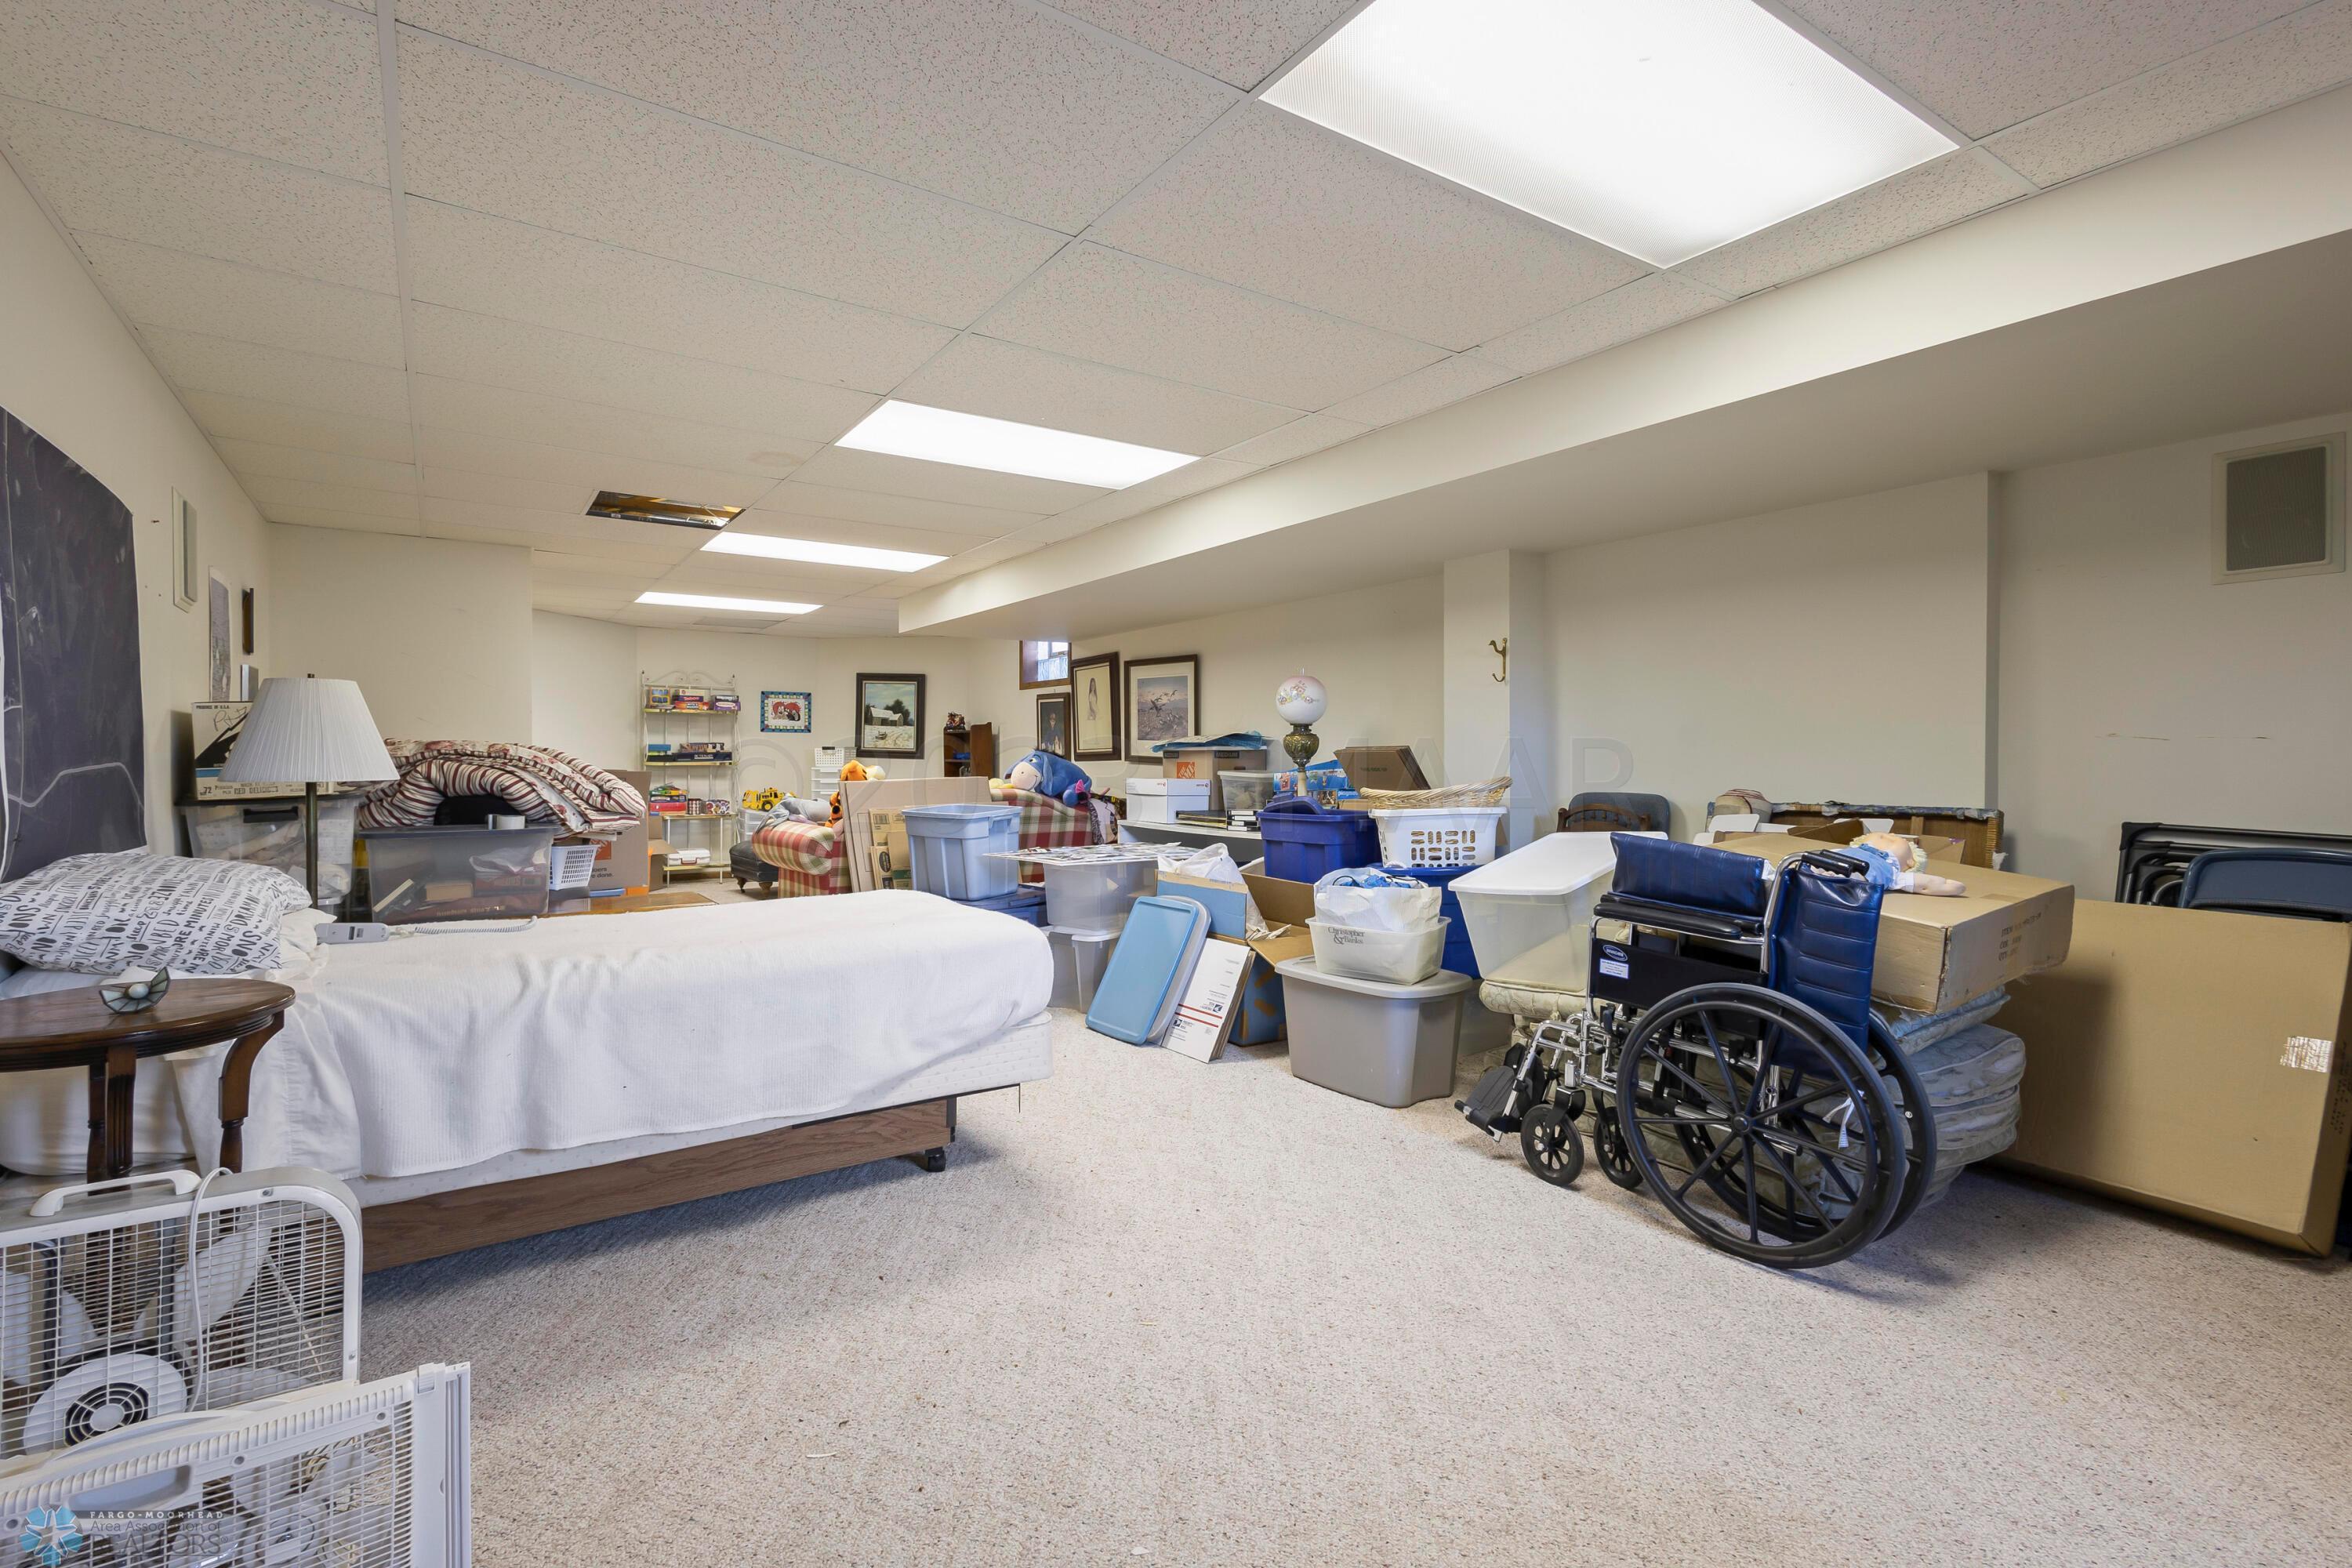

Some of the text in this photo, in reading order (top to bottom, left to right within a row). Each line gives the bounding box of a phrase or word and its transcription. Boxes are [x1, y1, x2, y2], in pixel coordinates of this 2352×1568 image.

[184, 898, 213, 928] MINUTES
[1328, 927, 1365, 938] Christopher
[1334, 934, 1363, 945] & Banks
